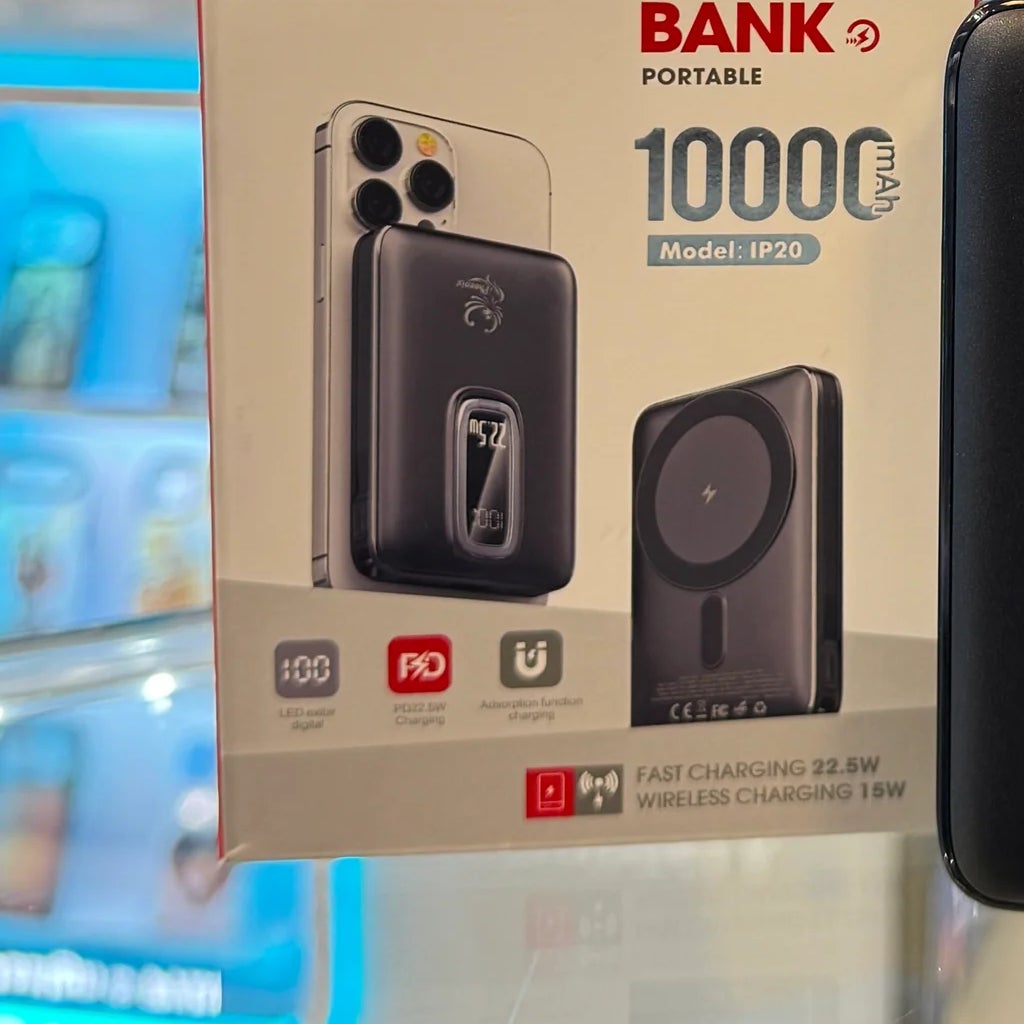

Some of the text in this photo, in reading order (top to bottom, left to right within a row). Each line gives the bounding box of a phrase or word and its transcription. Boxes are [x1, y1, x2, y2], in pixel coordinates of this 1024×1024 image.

[640, 1, 836, 53] BANK
[641, 67, 763, 86] PORTABLE
[659, 240, 803, 261] Model: IP20
[636, 755, 881, 784] FAST CHARGING 22.5W
[636, 780, 907, 810] WIRELESS CHARGING 15W
